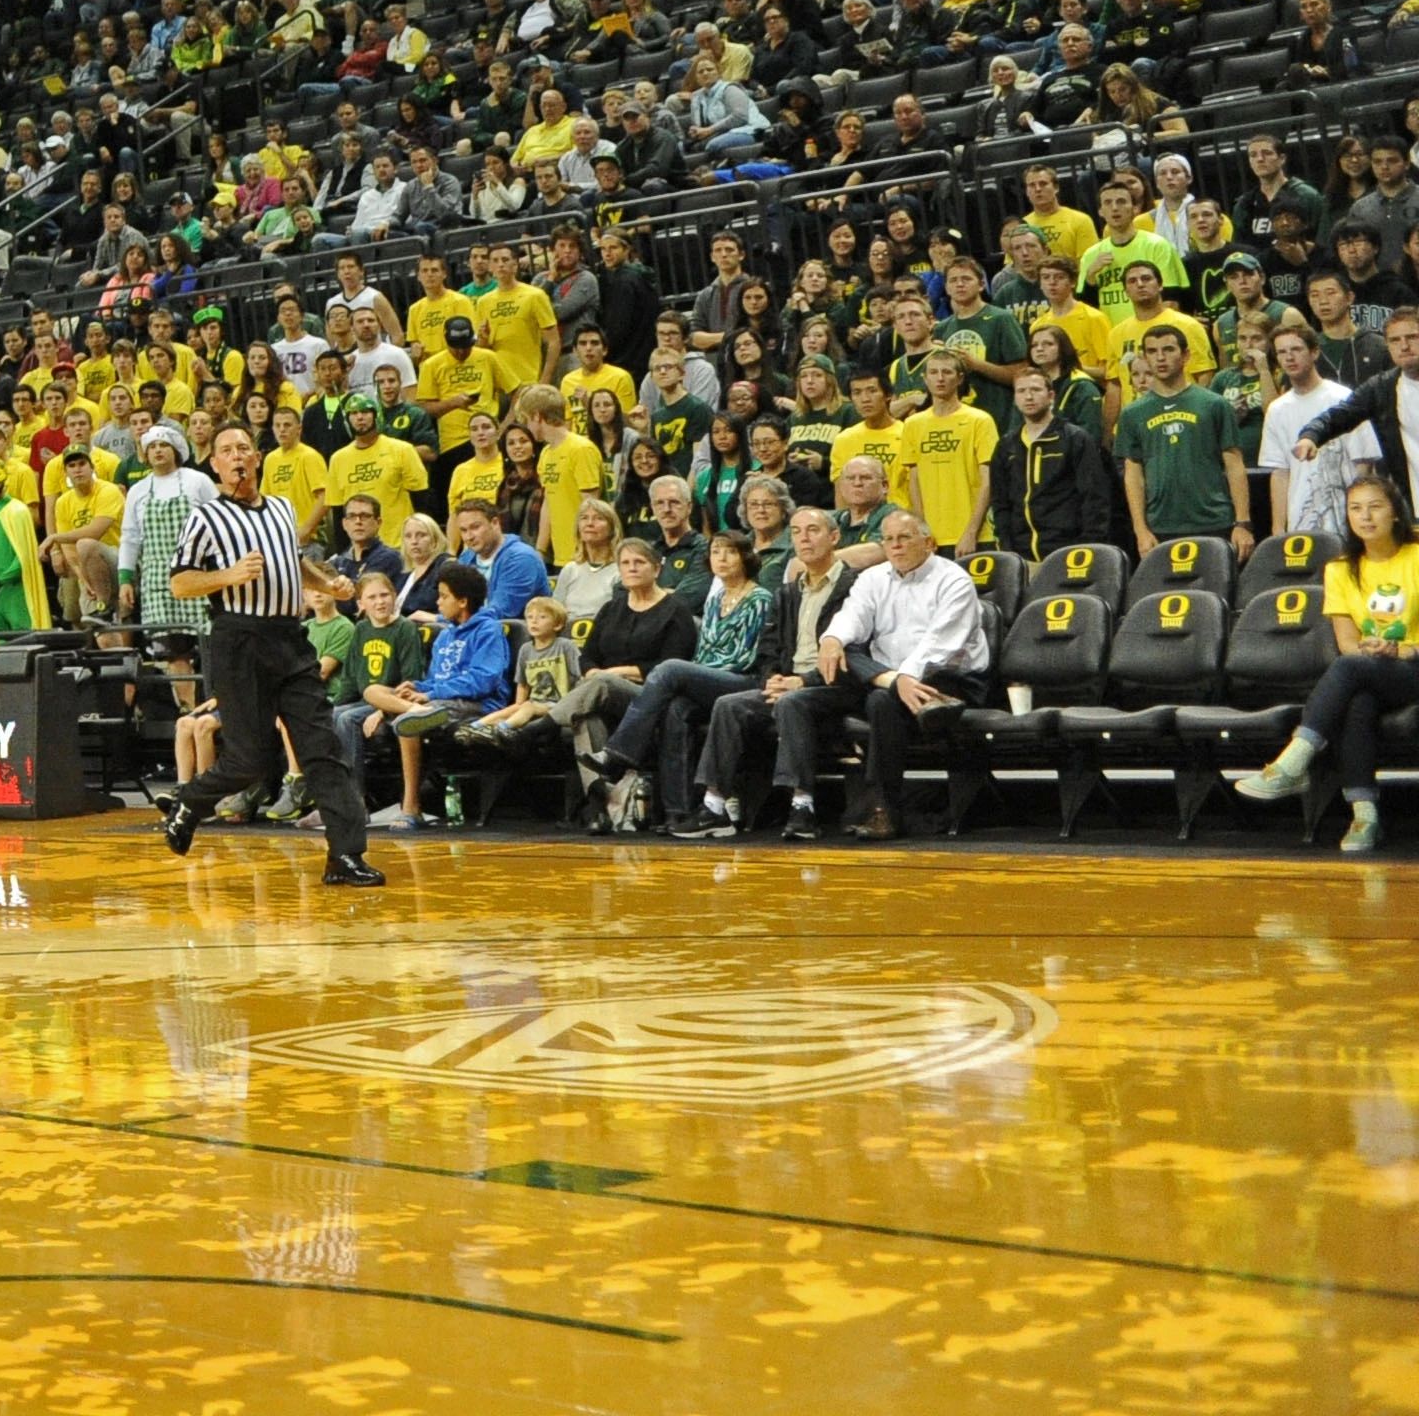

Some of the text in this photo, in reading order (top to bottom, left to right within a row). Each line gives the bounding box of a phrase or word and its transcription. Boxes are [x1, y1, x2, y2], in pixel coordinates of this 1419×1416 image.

[929, 430, 954, 442] PIT
[921, 439, 961, 454] CREW
[354, 460, 376, 472] PIT
[347, 470, 383, 485] CREW
